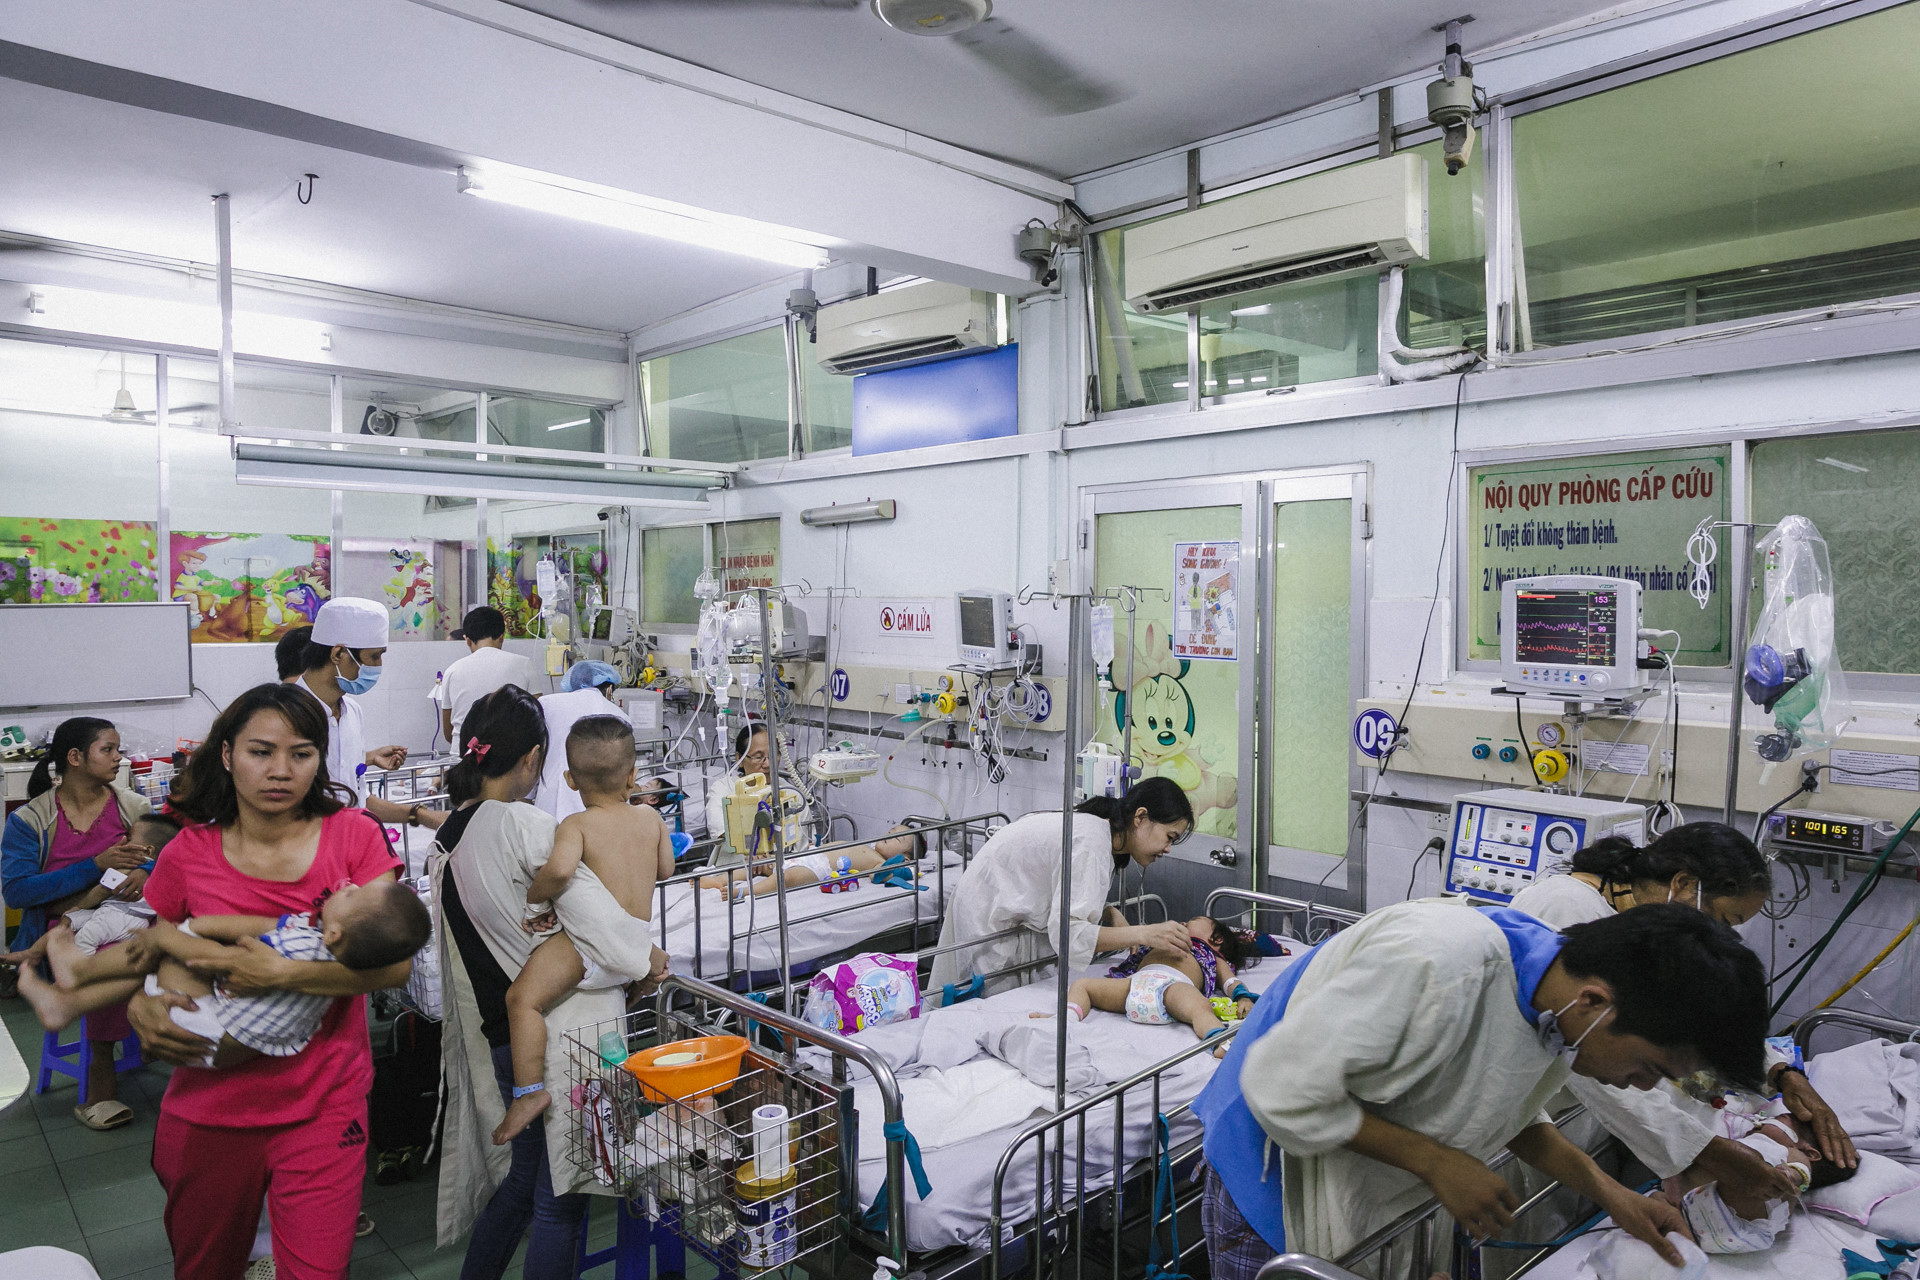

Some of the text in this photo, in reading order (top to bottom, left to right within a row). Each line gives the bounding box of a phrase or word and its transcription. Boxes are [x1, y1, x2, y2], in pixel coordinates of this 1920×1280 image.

[1485, 466, 1713, 513] NỘI QUY PHÒNG CẤP CỨU
[1484, 519, 1617, 552] 1/ Tuyệt đối không thăm bệnh.
[1483, 567, 1492, 591] 2/
[1649, 565, 1673, 590] nhân
[1676, 561, 1690, 590] cố
[898, 606, 931, 632] CẤM LỬA
[832, 674, 846, 697] 07
[1360, 716, 1394, 752] 09
[818, 760, 826, 769] 12
[1805, 822, 1821, 831] 100
[1831, 825, 1847, 835] 165
